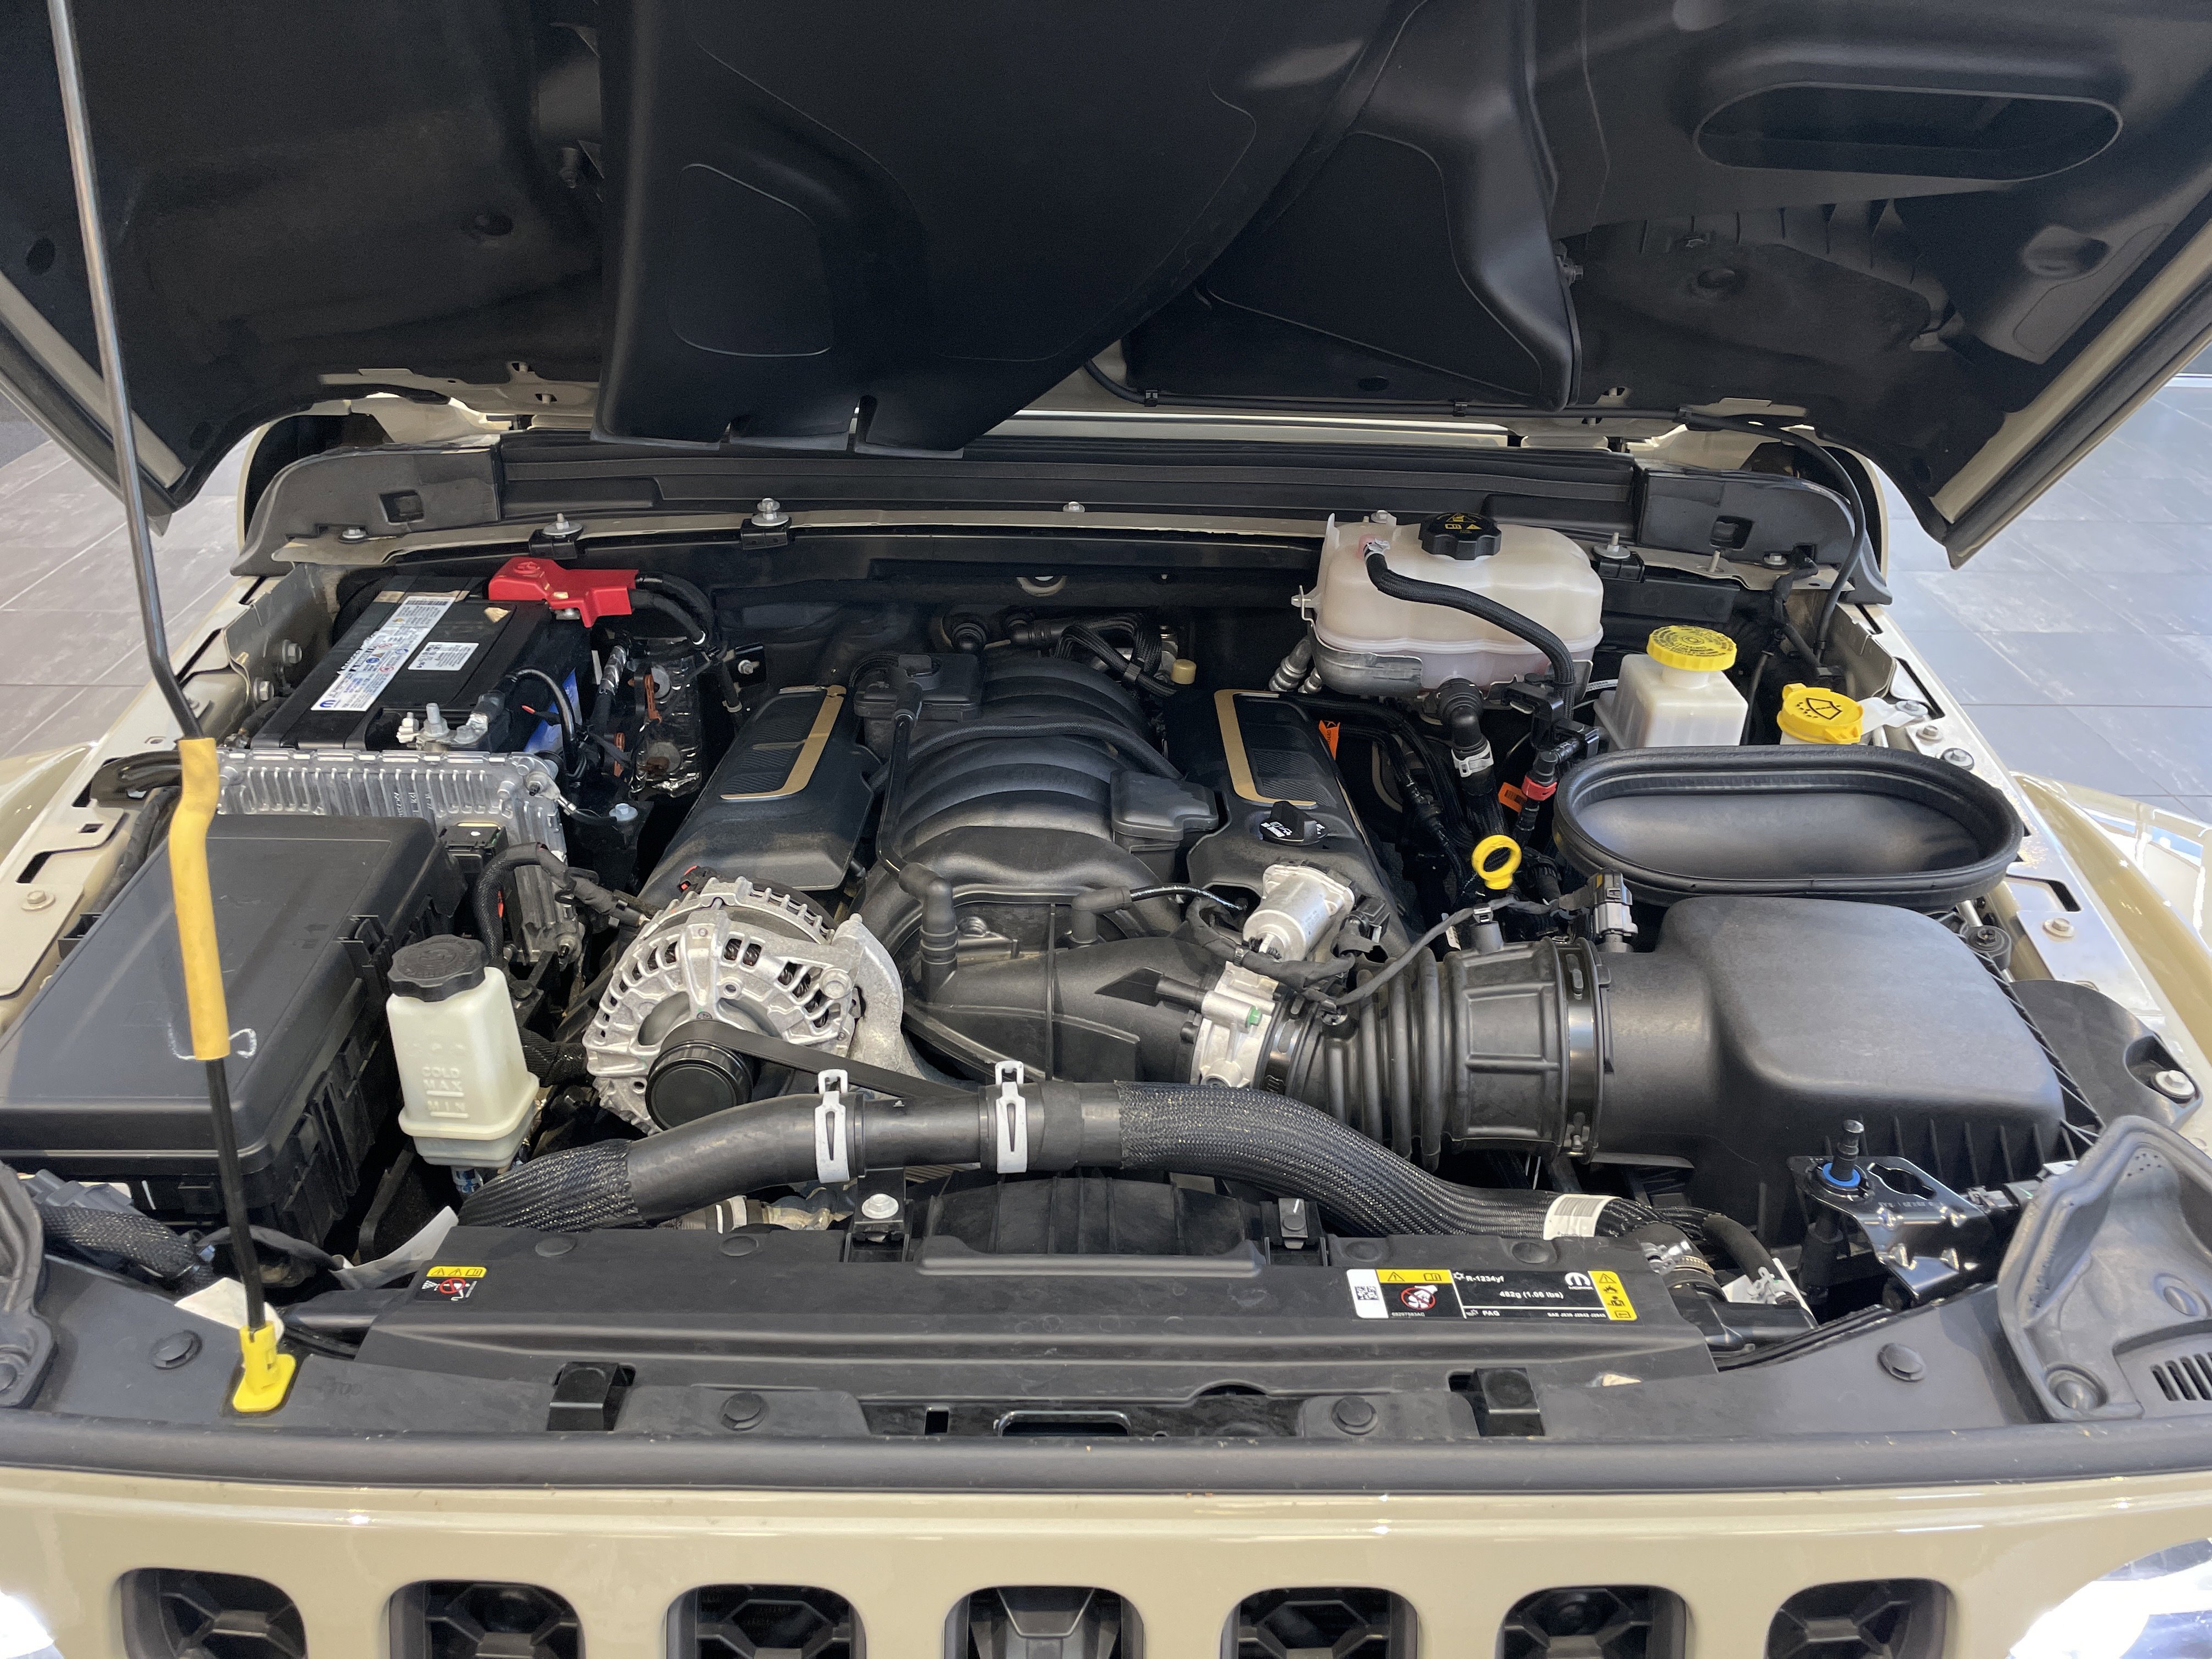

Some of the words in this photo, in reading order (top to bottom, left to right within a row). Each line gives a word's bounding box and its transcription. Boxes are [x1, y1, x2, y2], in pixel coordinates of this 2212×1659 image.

[422, 1066, 460, 1079] COLD
[422, 1079, 463, 1092] MAX
[427, 1101, 466, 1111] MIN
[1465, 1275, 1504, 1283] R-1234yf
